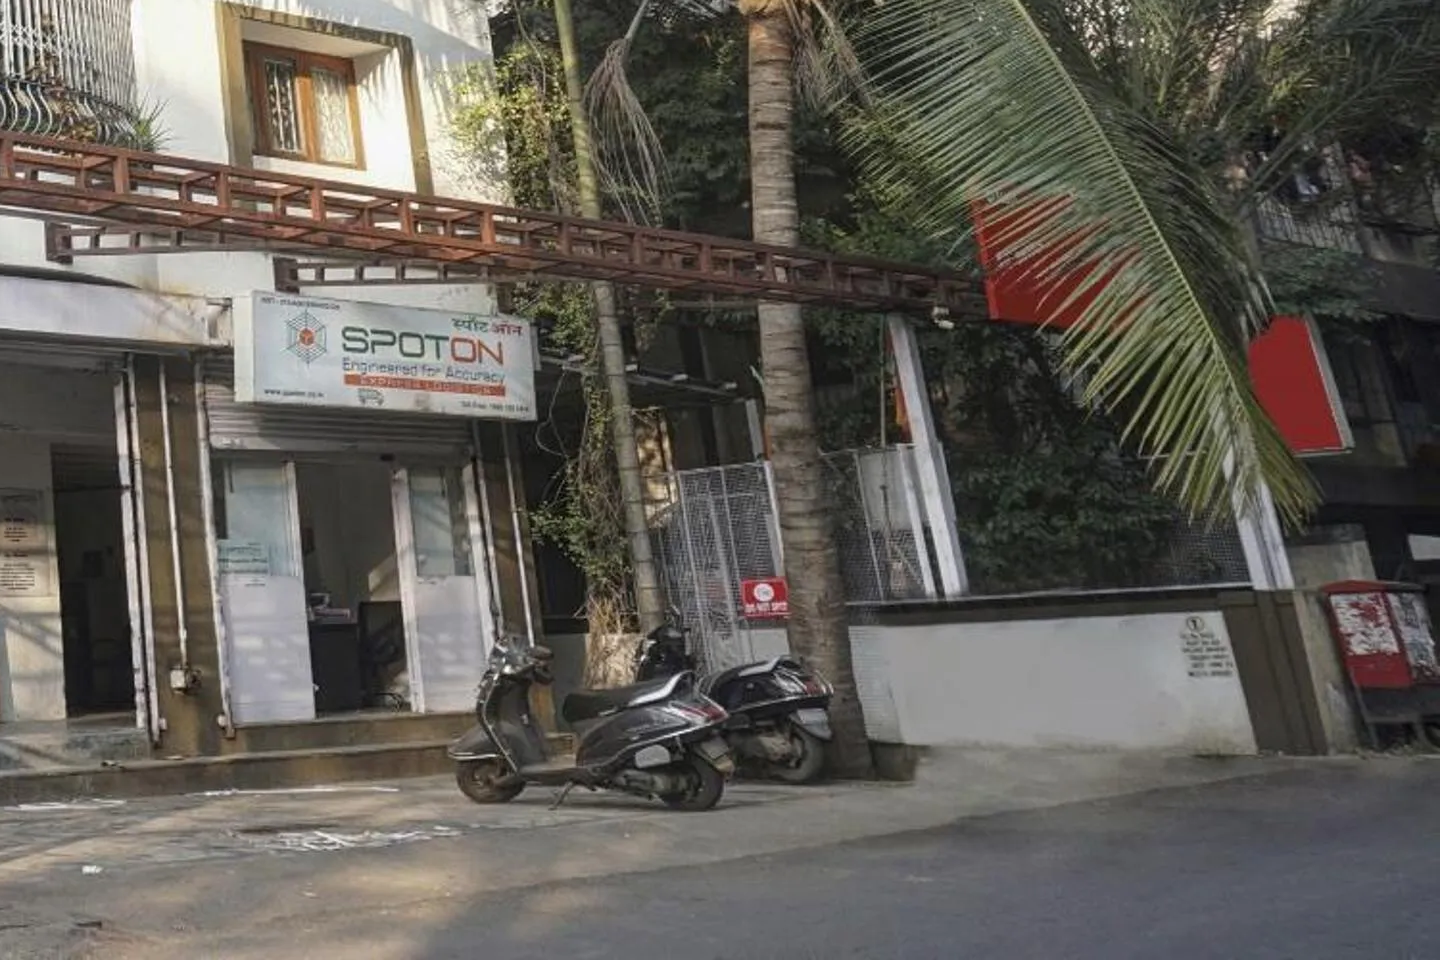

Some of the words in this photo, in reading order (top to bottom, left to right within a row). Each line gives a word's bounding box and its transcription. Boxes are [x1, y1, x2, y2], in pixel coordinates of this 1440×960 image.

[341, 325, 504, 366] SPOTON
[341, 356, 418, 377] Engineered
[422, 362, 441, 377] for
[445, 365, 506, 385] Accuracy
